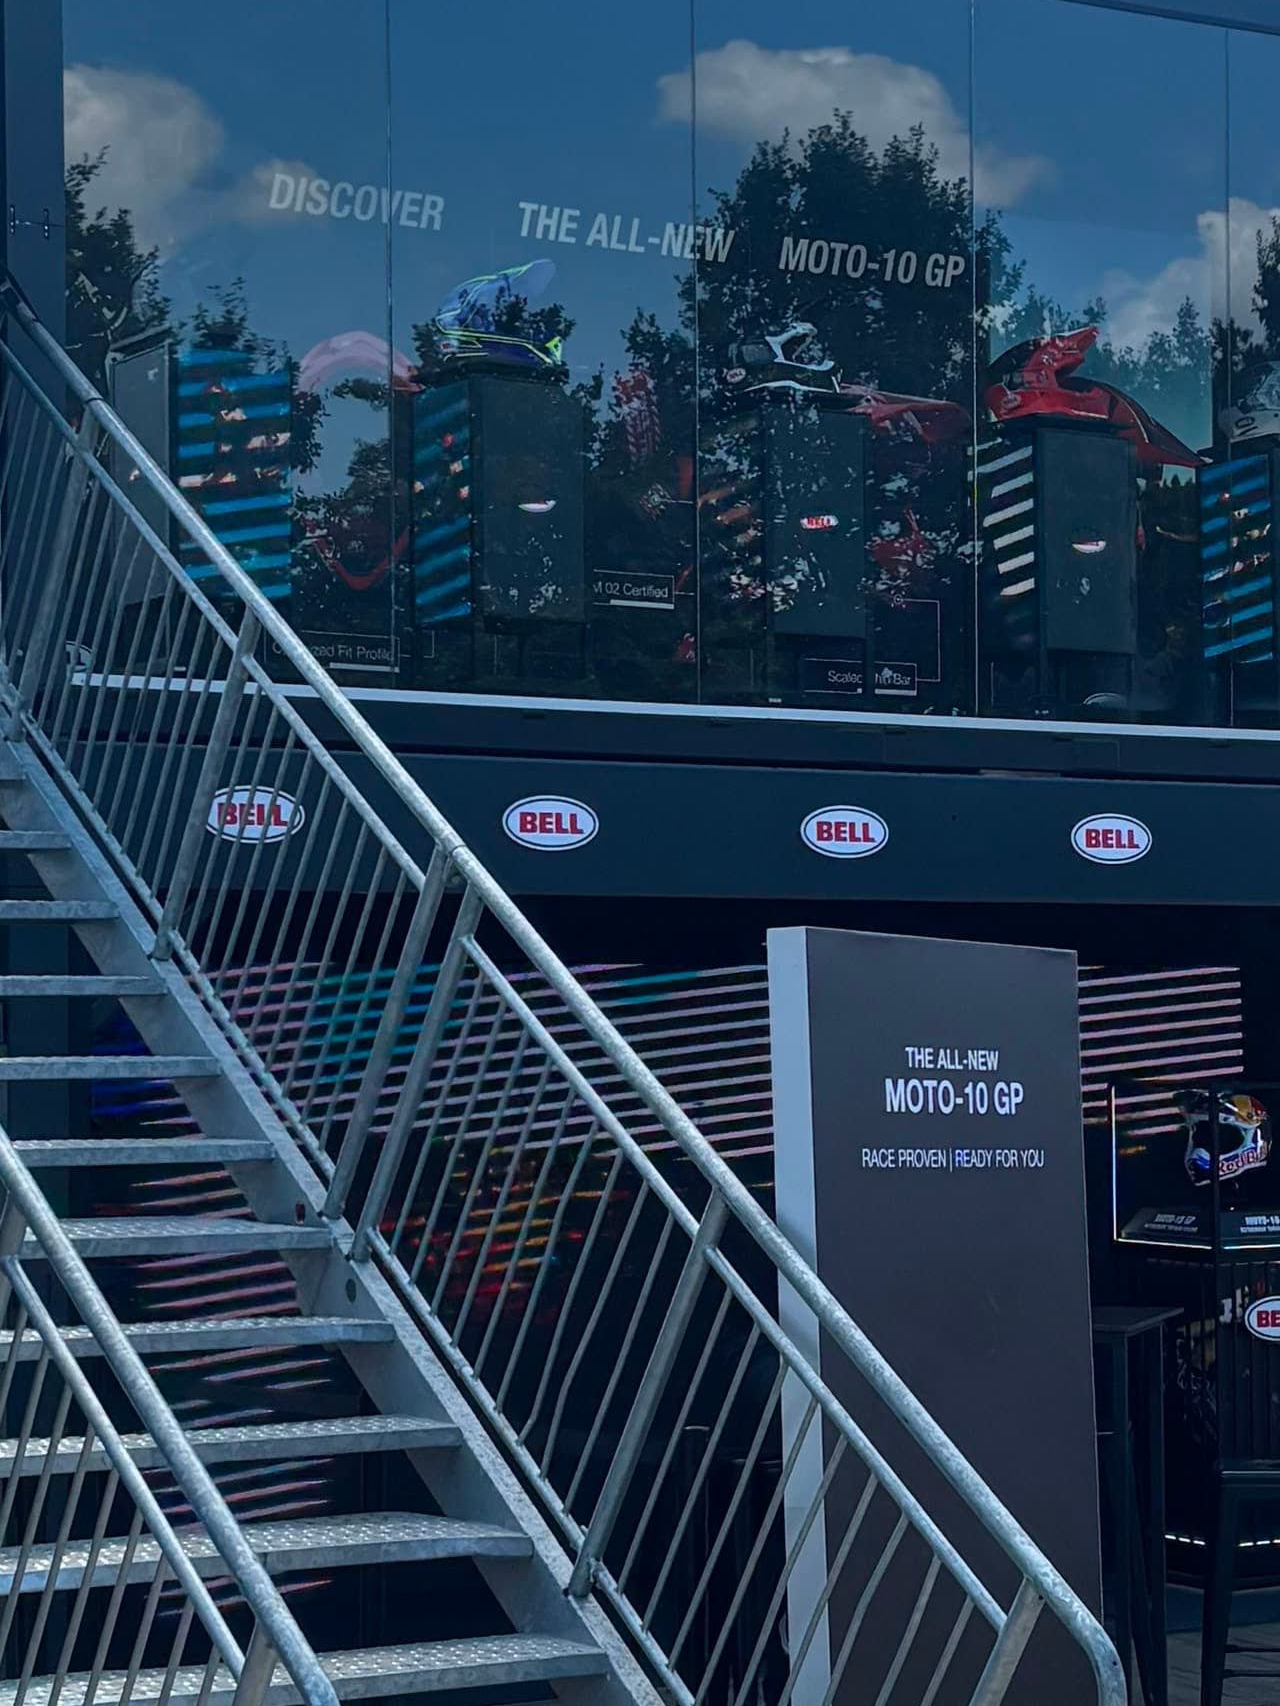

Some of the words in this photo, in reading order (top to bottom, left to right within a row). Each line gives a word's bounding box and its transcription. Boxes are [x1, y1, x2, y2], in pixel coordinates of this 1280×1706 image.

[269, 173, 445, 230] DISCOVER
[518, 201, 580, 244] THE
[586, 212, 735, 263] ALL-NEW
[779, 236, 918, 284] MOTO-10
[924, 252, 965, 288] GP
[623, 582, 669, 598] Certified
[217, 803, 289, 826] BELL
[519, 811, 584, 835] BELL
[816, 821, 876, 843] BELL
[1085, 828, 1141, 849] BELL
[905, 1047, 934, 1069] THE
[937, 1048, 999, 1071] ALL-NEW
[885, 1077, 988, 1115] MOTO-10
[994, 1081, 1024, 1115] GP
[862, 1148, 895, 1168] RACE
[898, 1148, 946, 1168] PROVEN
[955, 1149, 993, 1168] READY
[996, 1149, 1018, 1168] FOR
[1021, 1149, 1044, 1168] YOU
